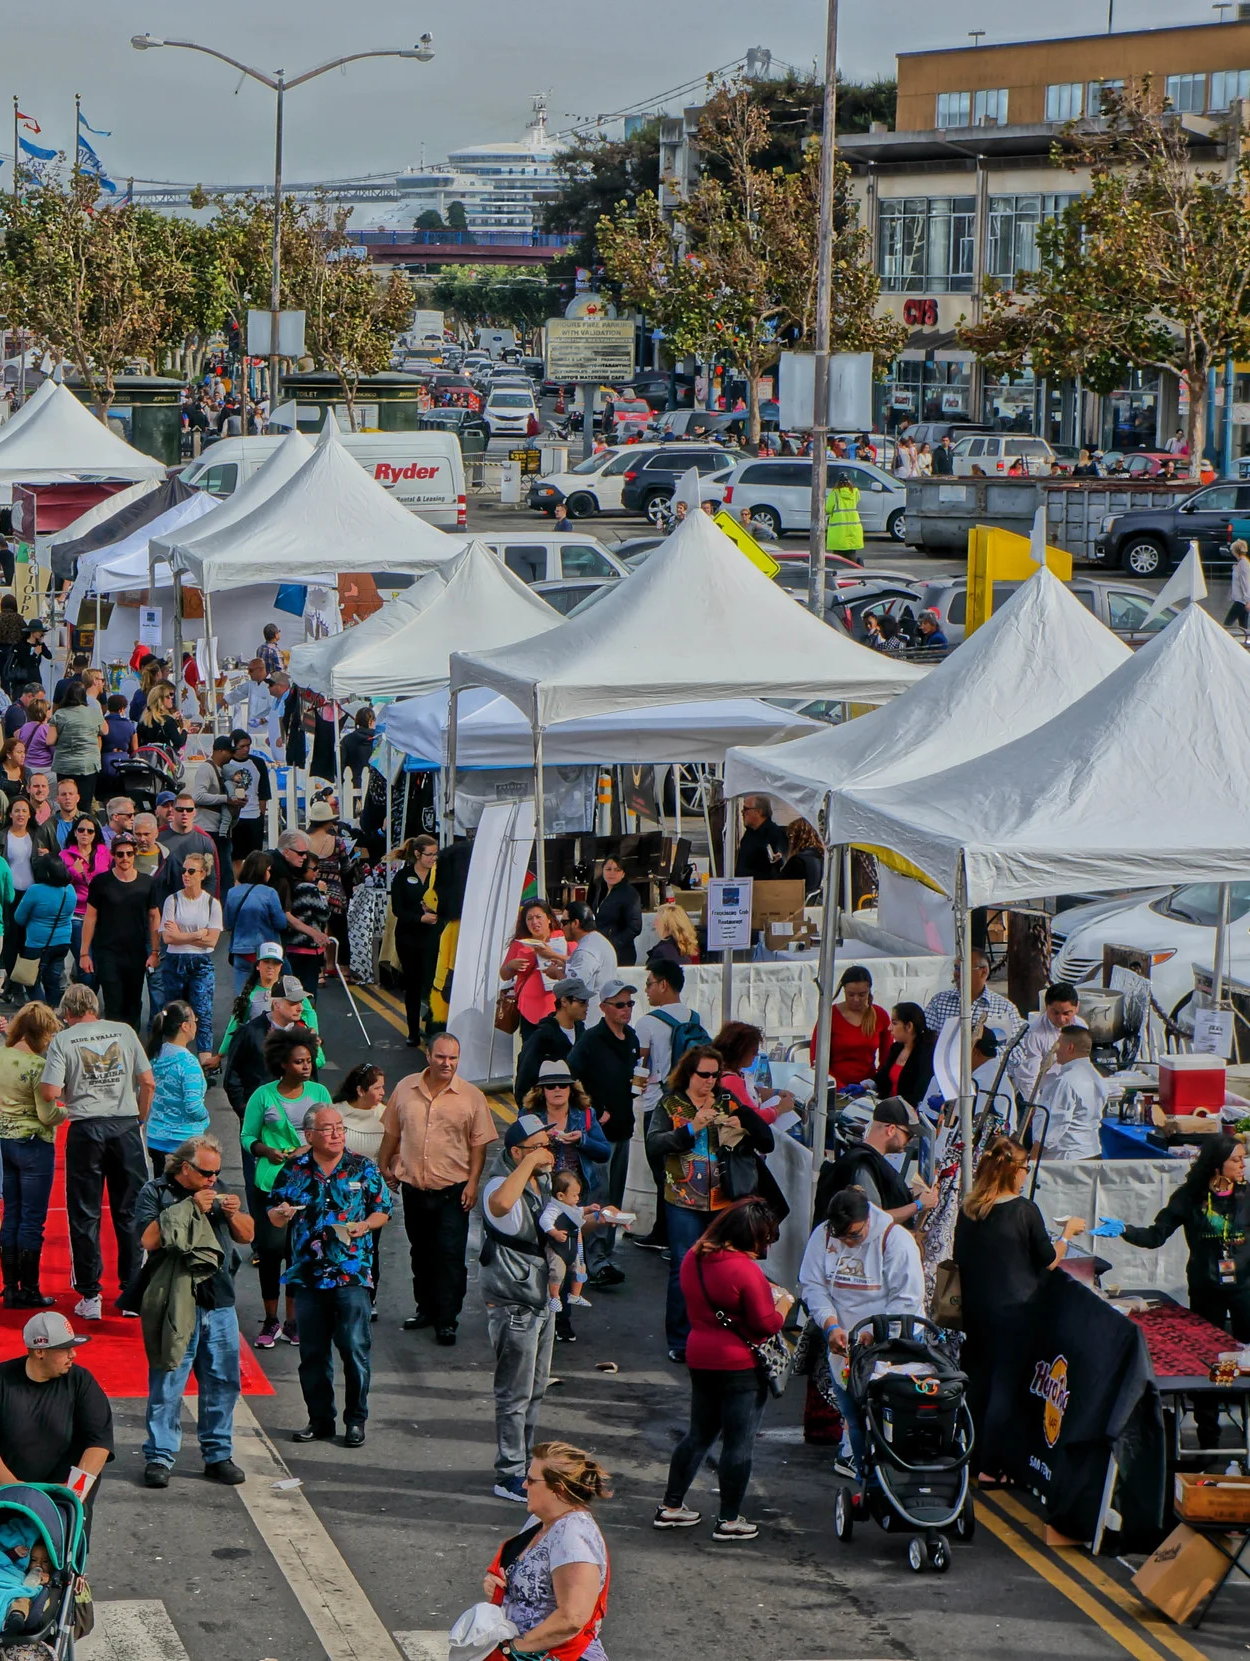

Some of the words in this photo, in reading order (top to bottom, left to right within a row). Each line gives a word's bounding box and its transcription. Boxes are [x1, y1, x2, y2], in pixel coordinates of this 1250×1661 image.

[903, 299, 938, 326] CVS
[374, 463, 440, 483] Ryder
[422, 495, 445, 503] Leasing
[20, 565, 35, 614] CIOPP
[70, 1036, 89, 1044] RIDE
[96, 1033, 123, 1041] VALLEY
